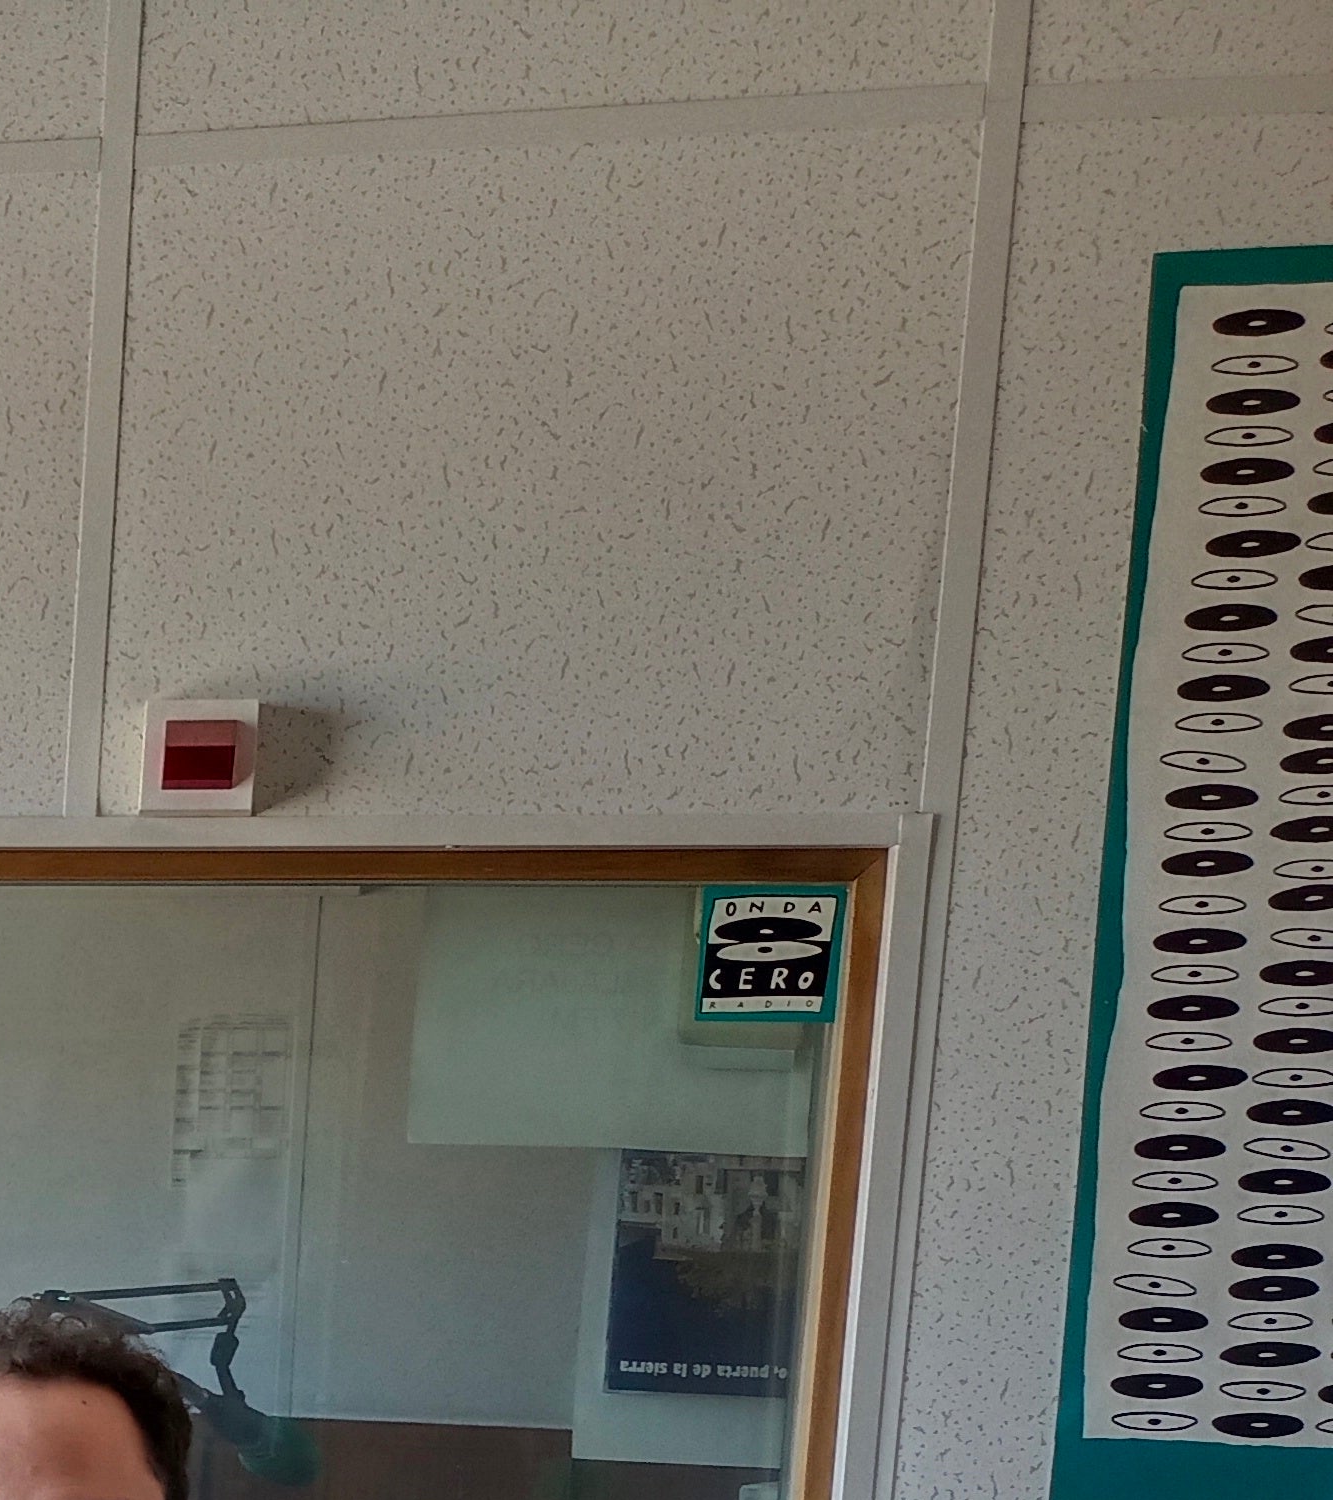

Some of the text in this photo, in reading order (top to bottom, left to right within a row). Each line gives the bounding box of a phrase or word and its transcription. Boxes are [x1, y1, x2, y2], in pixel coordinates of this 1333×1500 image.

[725, 901, 822, 917] ONDA
[708, 967, 815, 990] CERO
[709, 1000, 814, 1010] RADIO
[619, 1360, 668, 1376] sierra
[673, 1362, 688, 1377] la
[693, 1363, 712, 1378] de
[717, 1365, 769, 1378] puerta
